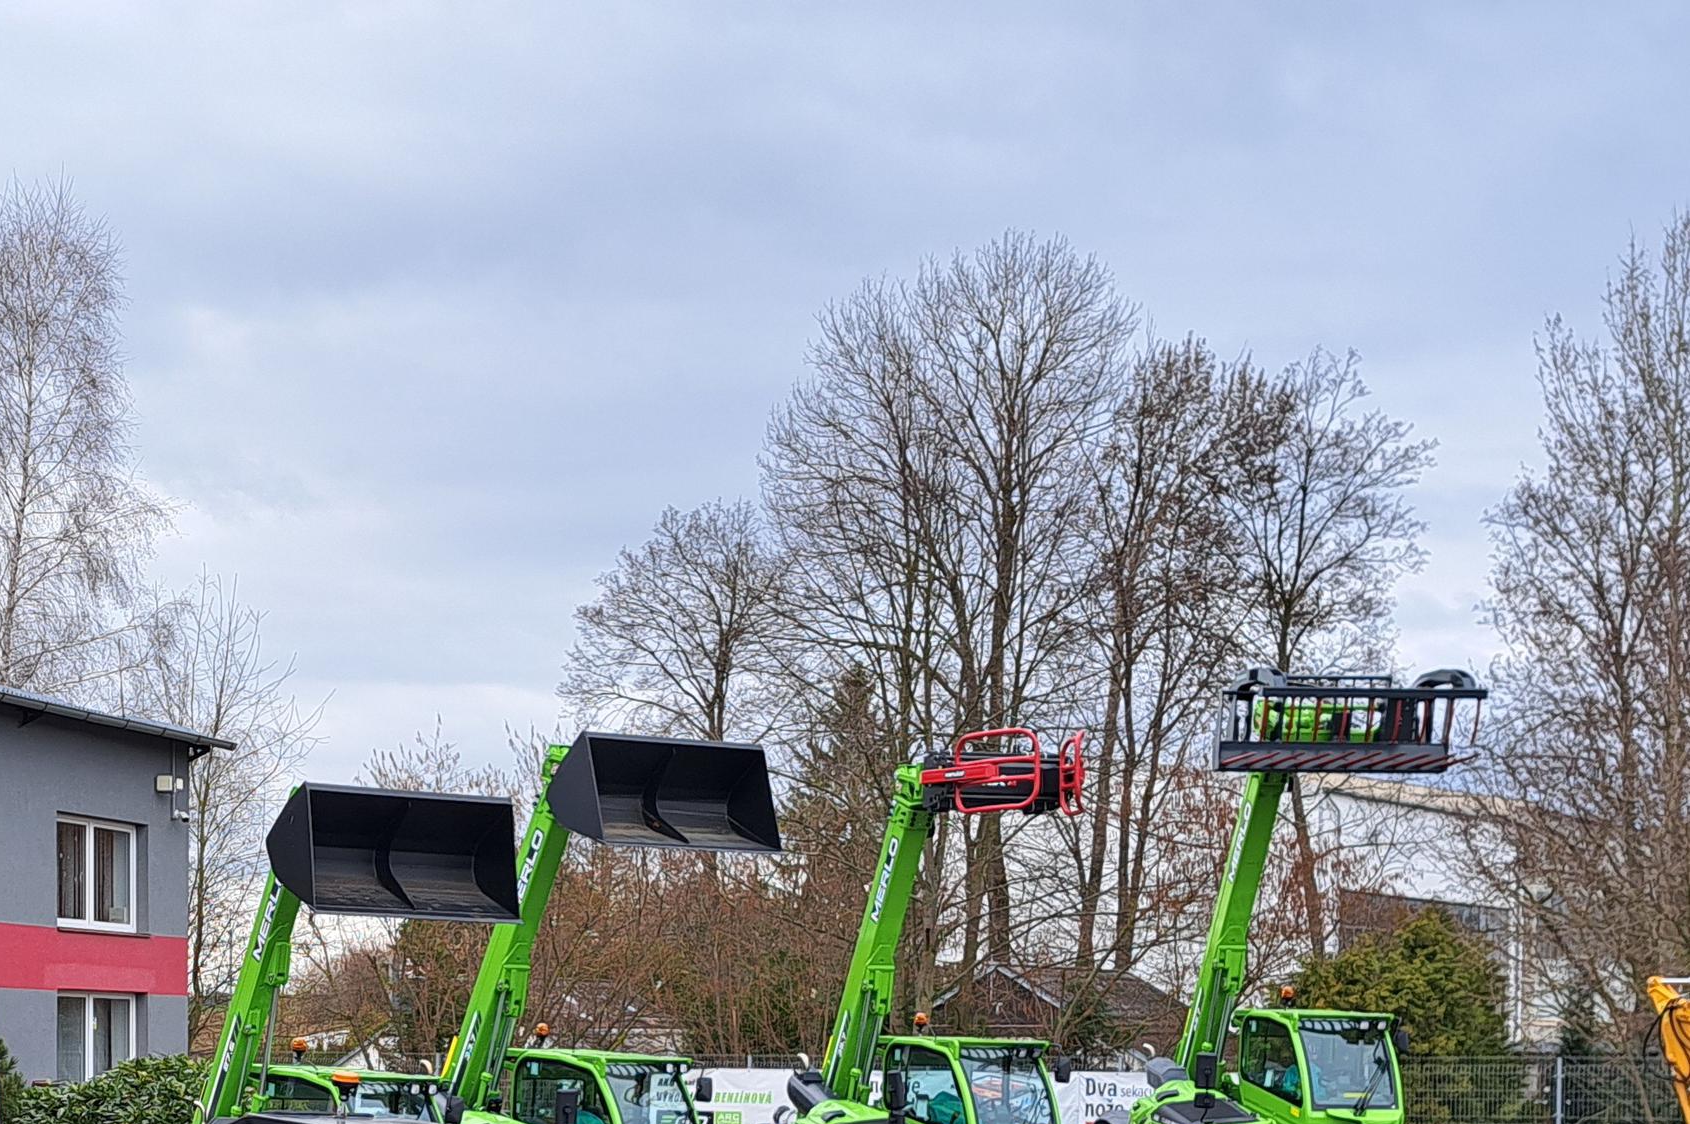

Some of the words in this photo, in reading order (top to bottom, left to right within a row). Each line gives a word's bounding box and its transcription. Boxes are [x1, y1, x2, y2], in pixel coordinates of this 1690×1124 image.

[517, 829, 544, 905] ERLO
[871, 837, 898, 922] MERLO
[1228, 802, 1252, 883] MERLO
[252, 877, 282, 961] MERL
[714, 1090, 774, 1104] BENZÍNOVÁ
[1085, 1078, 1117, 1097] Dva
